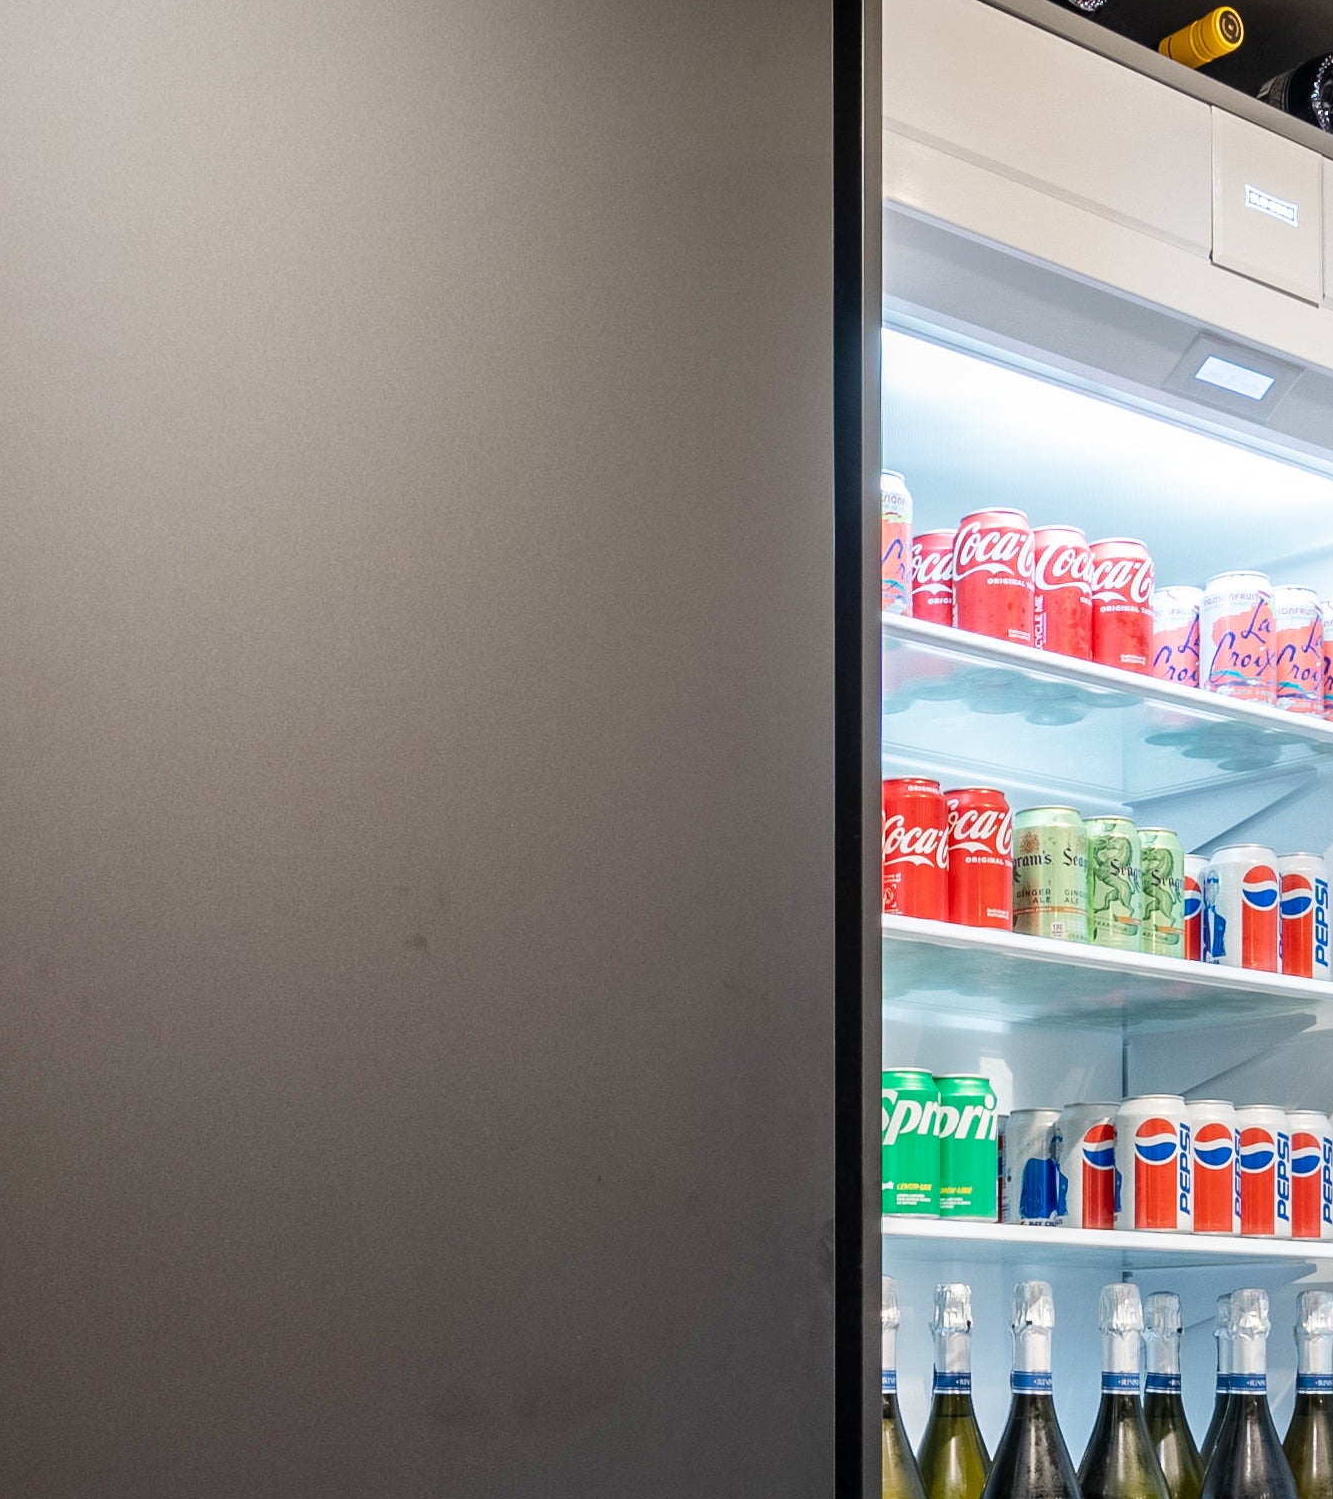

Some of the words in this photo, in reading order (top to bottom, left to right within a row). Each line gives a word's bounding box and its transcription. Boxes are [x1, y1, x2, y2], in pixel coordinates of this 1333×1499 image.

[1241, 598, 1271, 644] La
[965, 856, 1004, 866] ORIGINAL
[1016, 888, 1051, 899] GINGER
[1033, 896, 1052, 904] ALE
[1315, 877, 1329, 967] PEPSI
[1179, 1122, 1191, 1216] PEPSI
[1277, 1131, 1290, 1222] PEPSI
[1323, 1136, 1333, 1225] PEPSI
